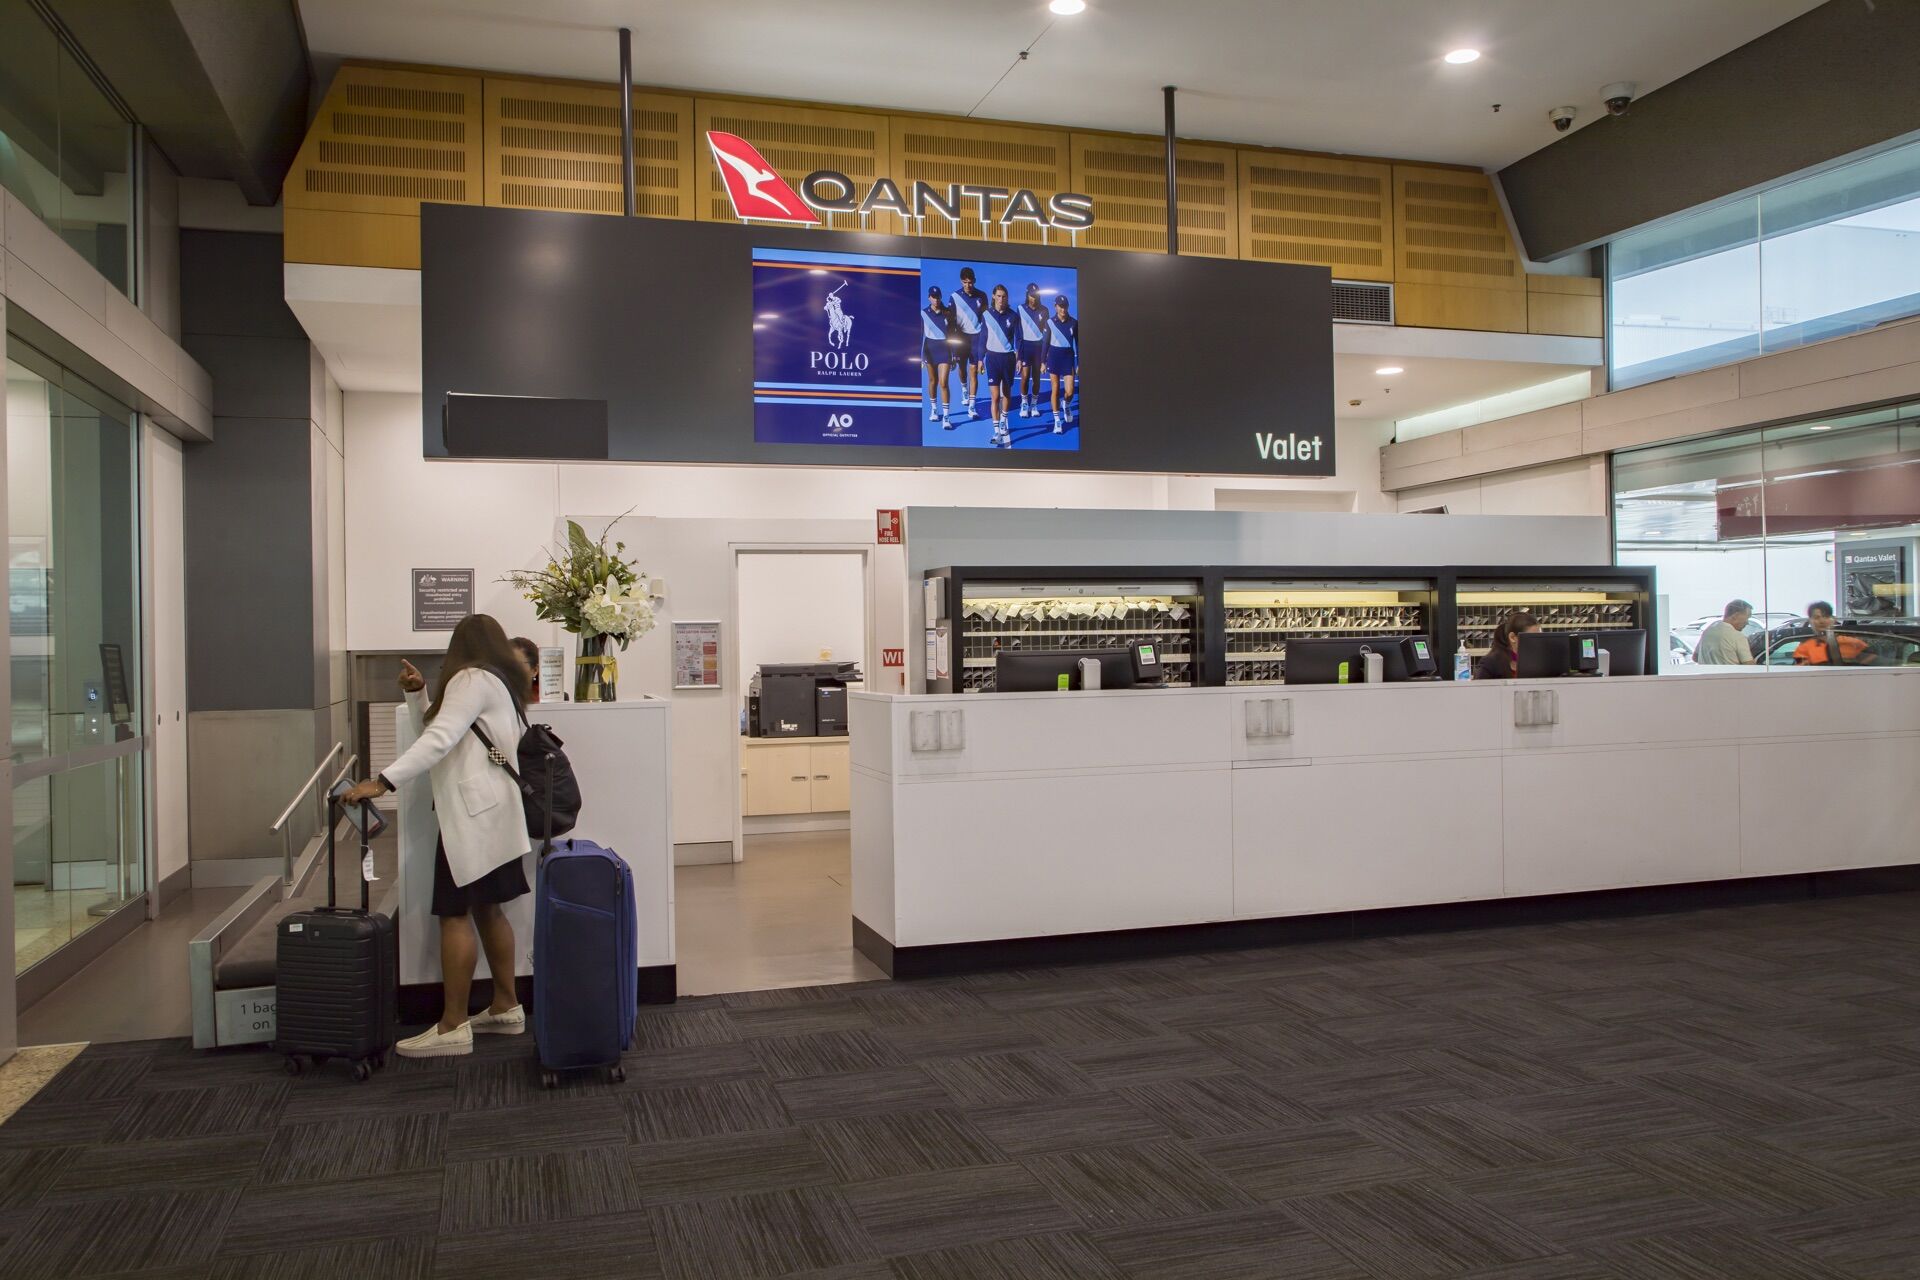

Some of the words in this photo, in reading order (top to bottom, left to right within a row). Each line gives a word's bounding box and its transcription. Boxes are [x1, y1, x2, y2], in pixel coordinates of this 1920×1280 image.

[801, 170, 1094, 230] QANTAS
[810, 351, 869, 371] POLO
[827, 413, 853, 428] AO
[1255, 432, 1323, 461] Valet
[1878, 553, 1896, 561] Valet
[883, 651, 904, 664] WI
[241, 1004, 246, 1015] 1
[252, 1020, 270, 1030] on
